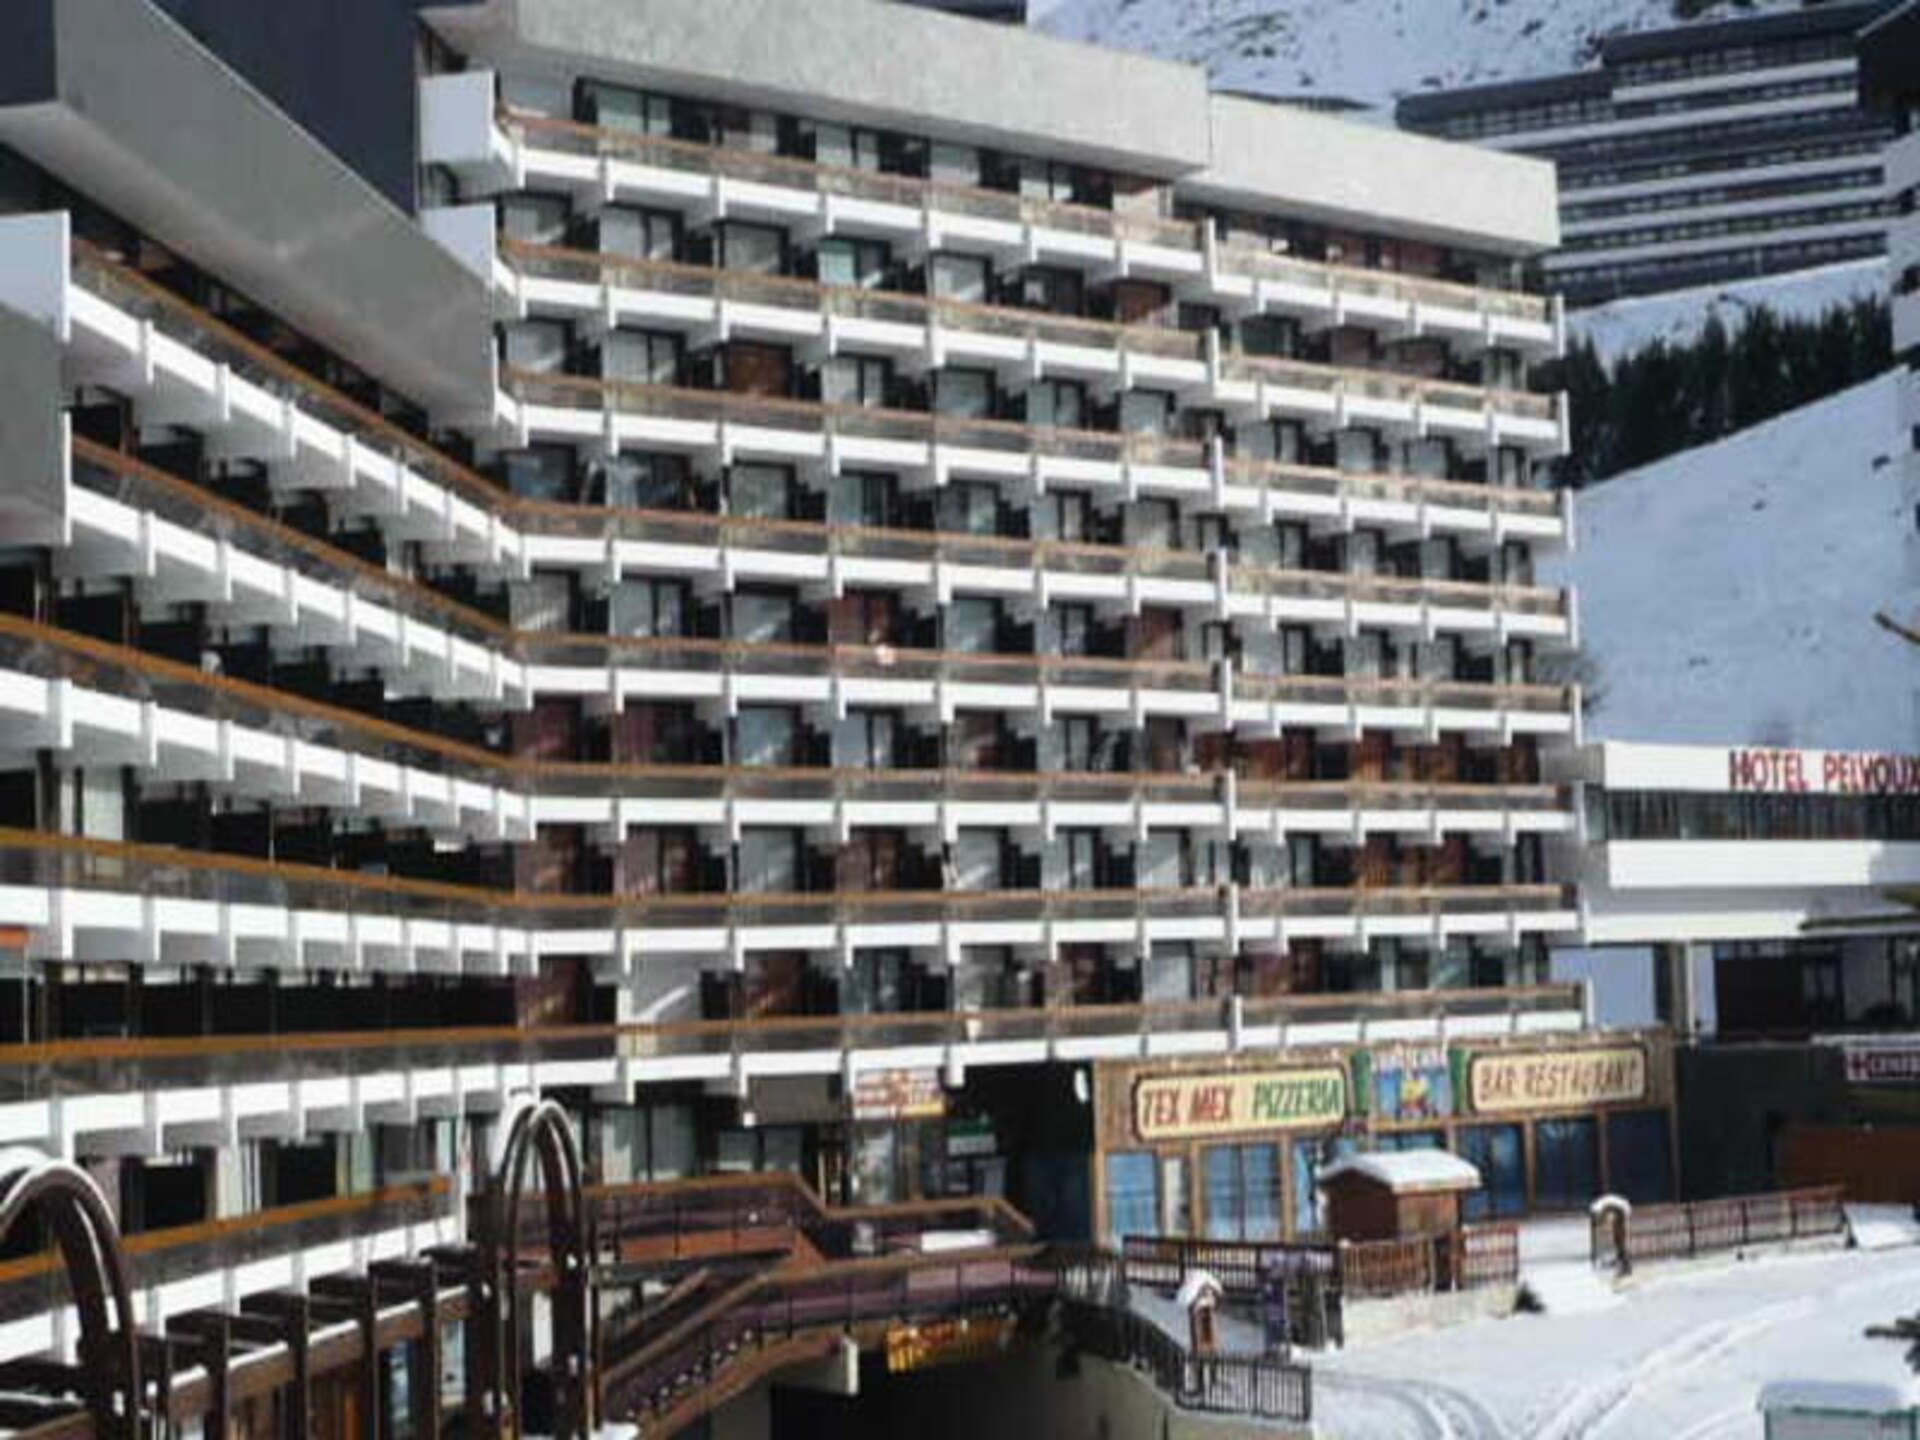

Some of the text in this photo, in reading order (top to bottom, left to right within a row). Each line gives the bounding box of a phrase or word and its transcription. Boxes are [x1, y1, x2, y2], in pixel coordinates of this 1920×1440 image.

[1728, 749, 1808, 793] HOTEL
[1144, 1078, 1341, 1127] TEX MEX PIZZERIA
[1478, 1059, 1638, 1102] BAR RESTAURANT
